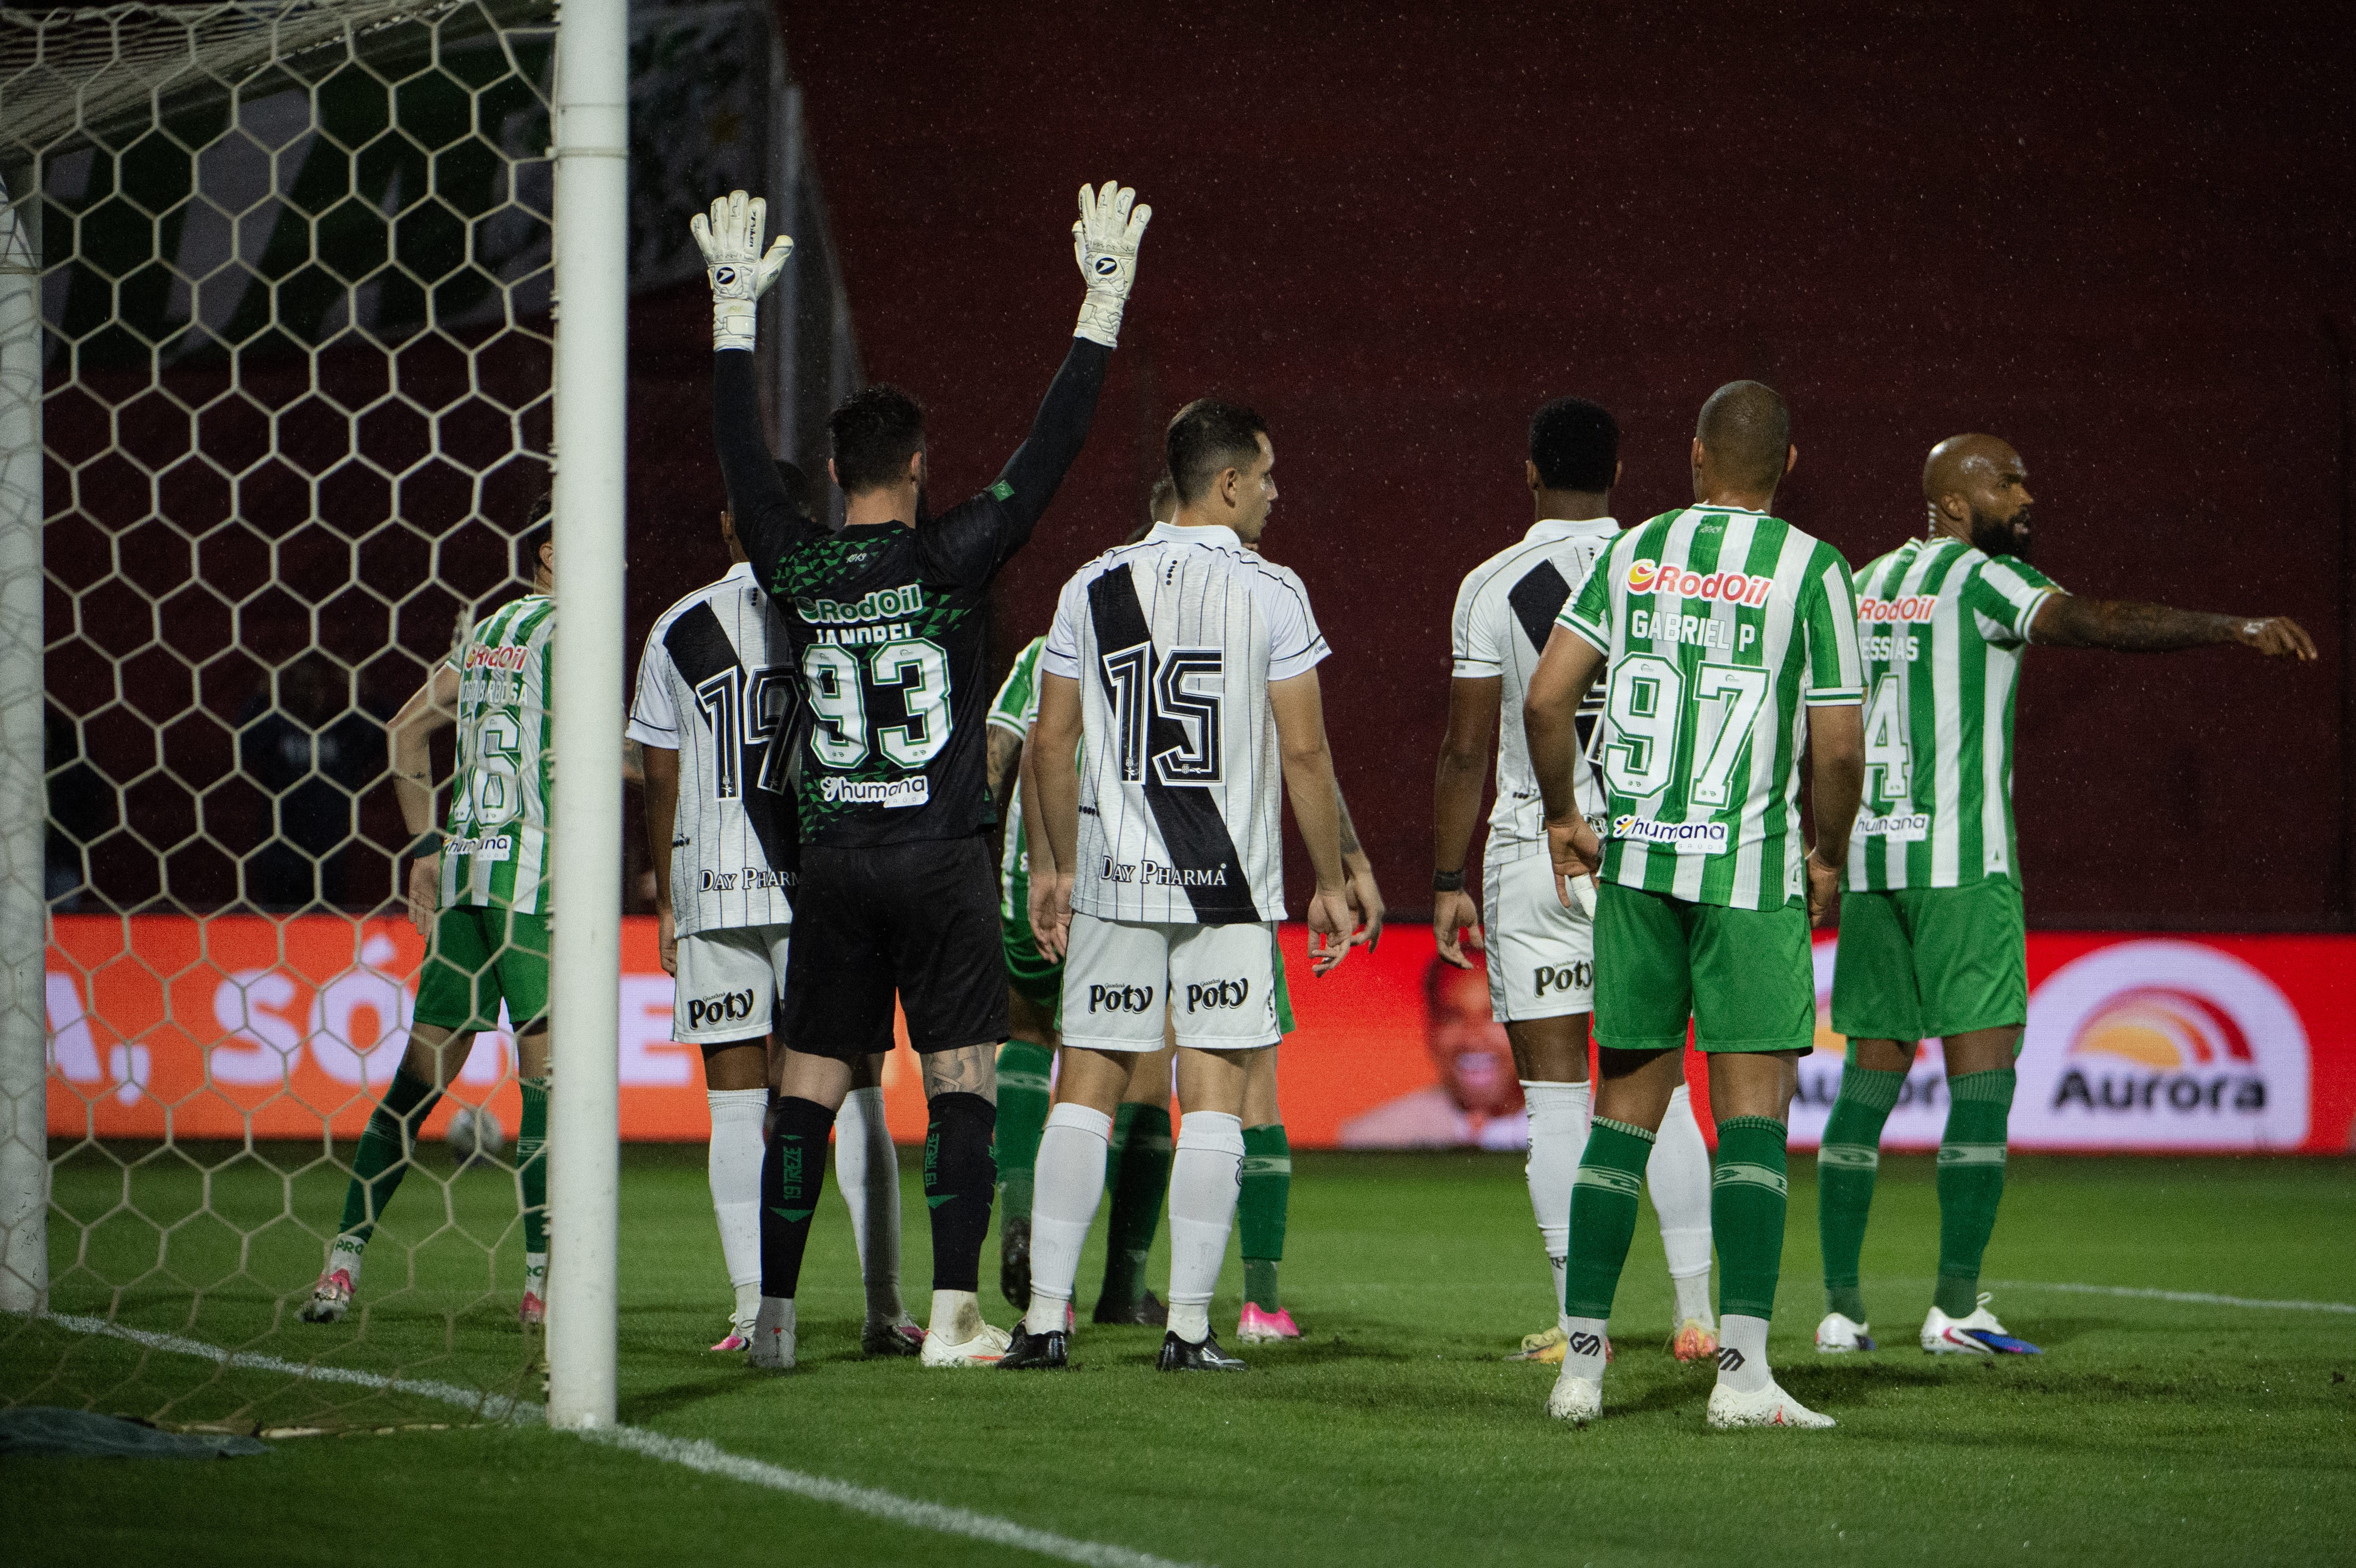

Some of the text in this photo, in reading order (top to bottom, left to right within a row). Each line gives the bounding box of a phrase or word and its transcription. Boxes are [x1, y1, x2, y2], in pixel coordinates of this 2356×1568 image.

[818, 586, 920, 620] RodOil
[1655, 566, 1770, 605] RodOil
[1857, 598, 1936, 620] RodOil
[1632, 610, 1755, 652] GABRIEL P
[1858, 636, 1919, 662] ESSIAS
[802, 638, 953, 769] 93
[1102, 641, 1226, 786] 15
[696, 665, 800, 802] 19
[1603, 652, 1771, 809] 97
[1865, 673, 1911, 799] 4
[841, 778, 925, 799] humana
[1631, 818, 1725, 840] humana
[1855, 816, 1925, 832] humana
[699, 870, 737, 892] DAY
[1101, 856, 1135, 883] DAY
[211, 934, 417, 1086] SÓ
[687, 988, 755, 1030] Poty
[1088, 984, 1154, 1015] Poty
[1186, 978, 1249, 1015] Poty
[2048, 1067, 2268, 1115] Aurora
